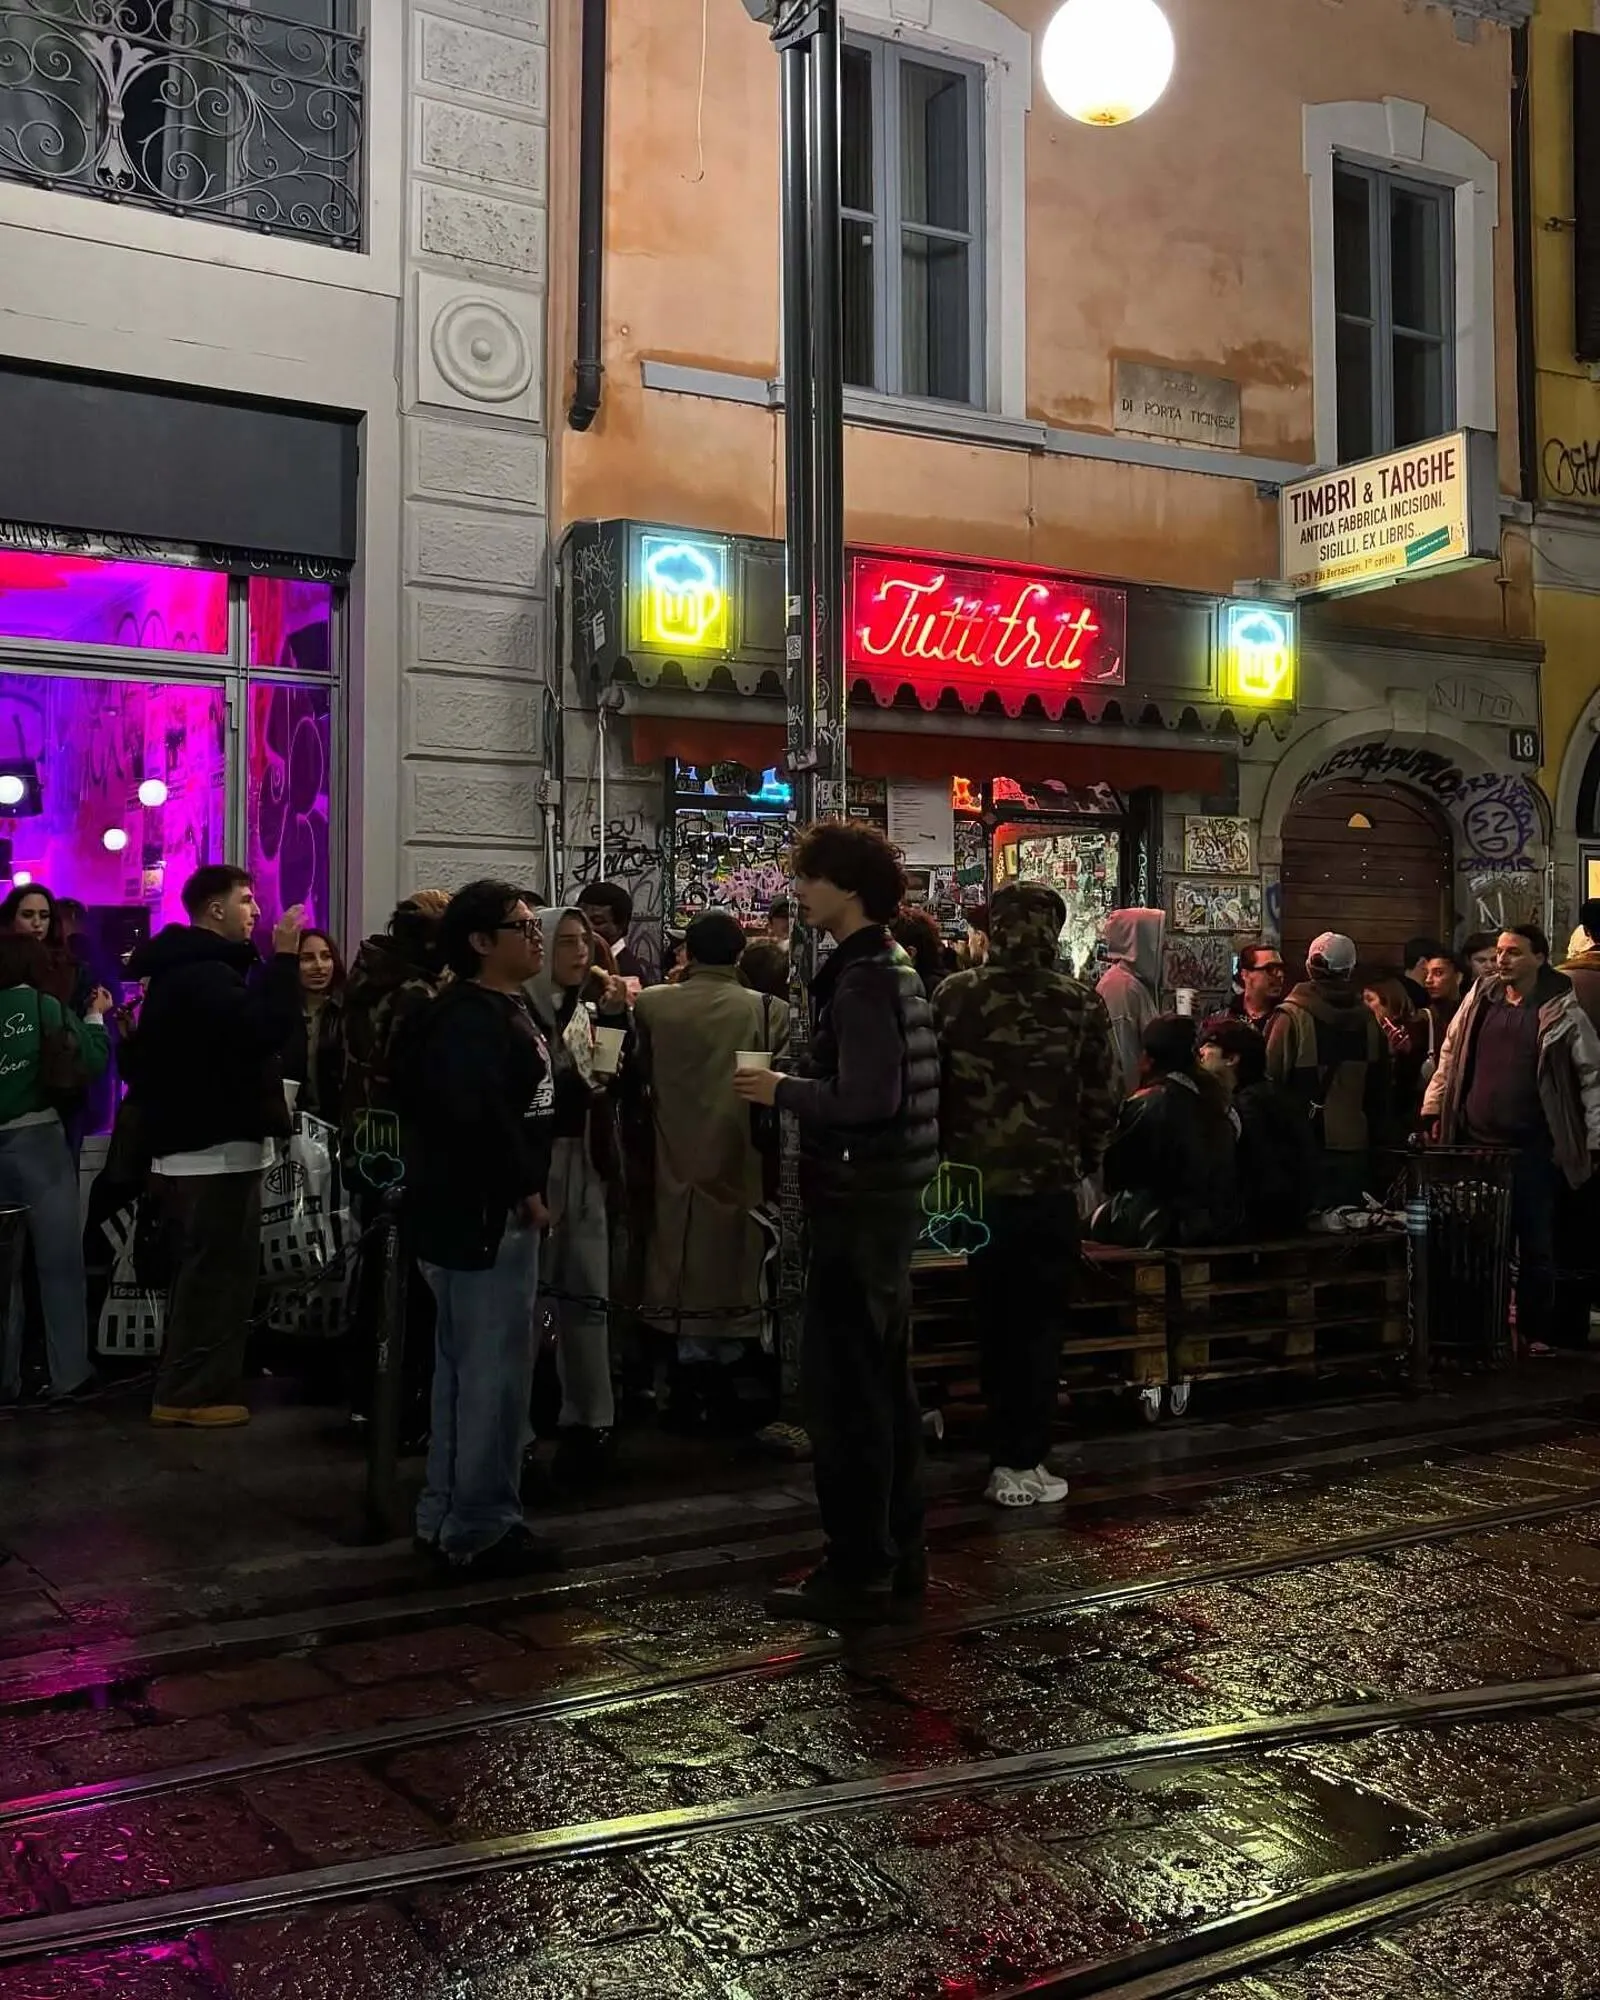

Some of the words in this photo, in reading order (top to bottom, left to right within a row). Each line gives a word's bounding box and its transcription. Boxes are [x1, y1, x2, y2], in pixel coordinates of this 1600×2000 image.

[1122, 399, 1133, 412] DI
[1144, 402, 1182, 420] PORTA
[1191, 410, 1236, 429] TICINESE
[1290, 477, 1356, 524] TIMBRI
[1363, 482, 1373, 503] &
[1378, 448, 1455, 498] TARGHE
[1300, 520, 1335, 545] ANTICA
[1338, 508, 1387, 533] FABBRICA
[1363, 532, 1376, 551] EX
[1515, 735, 1534, 757] 18
